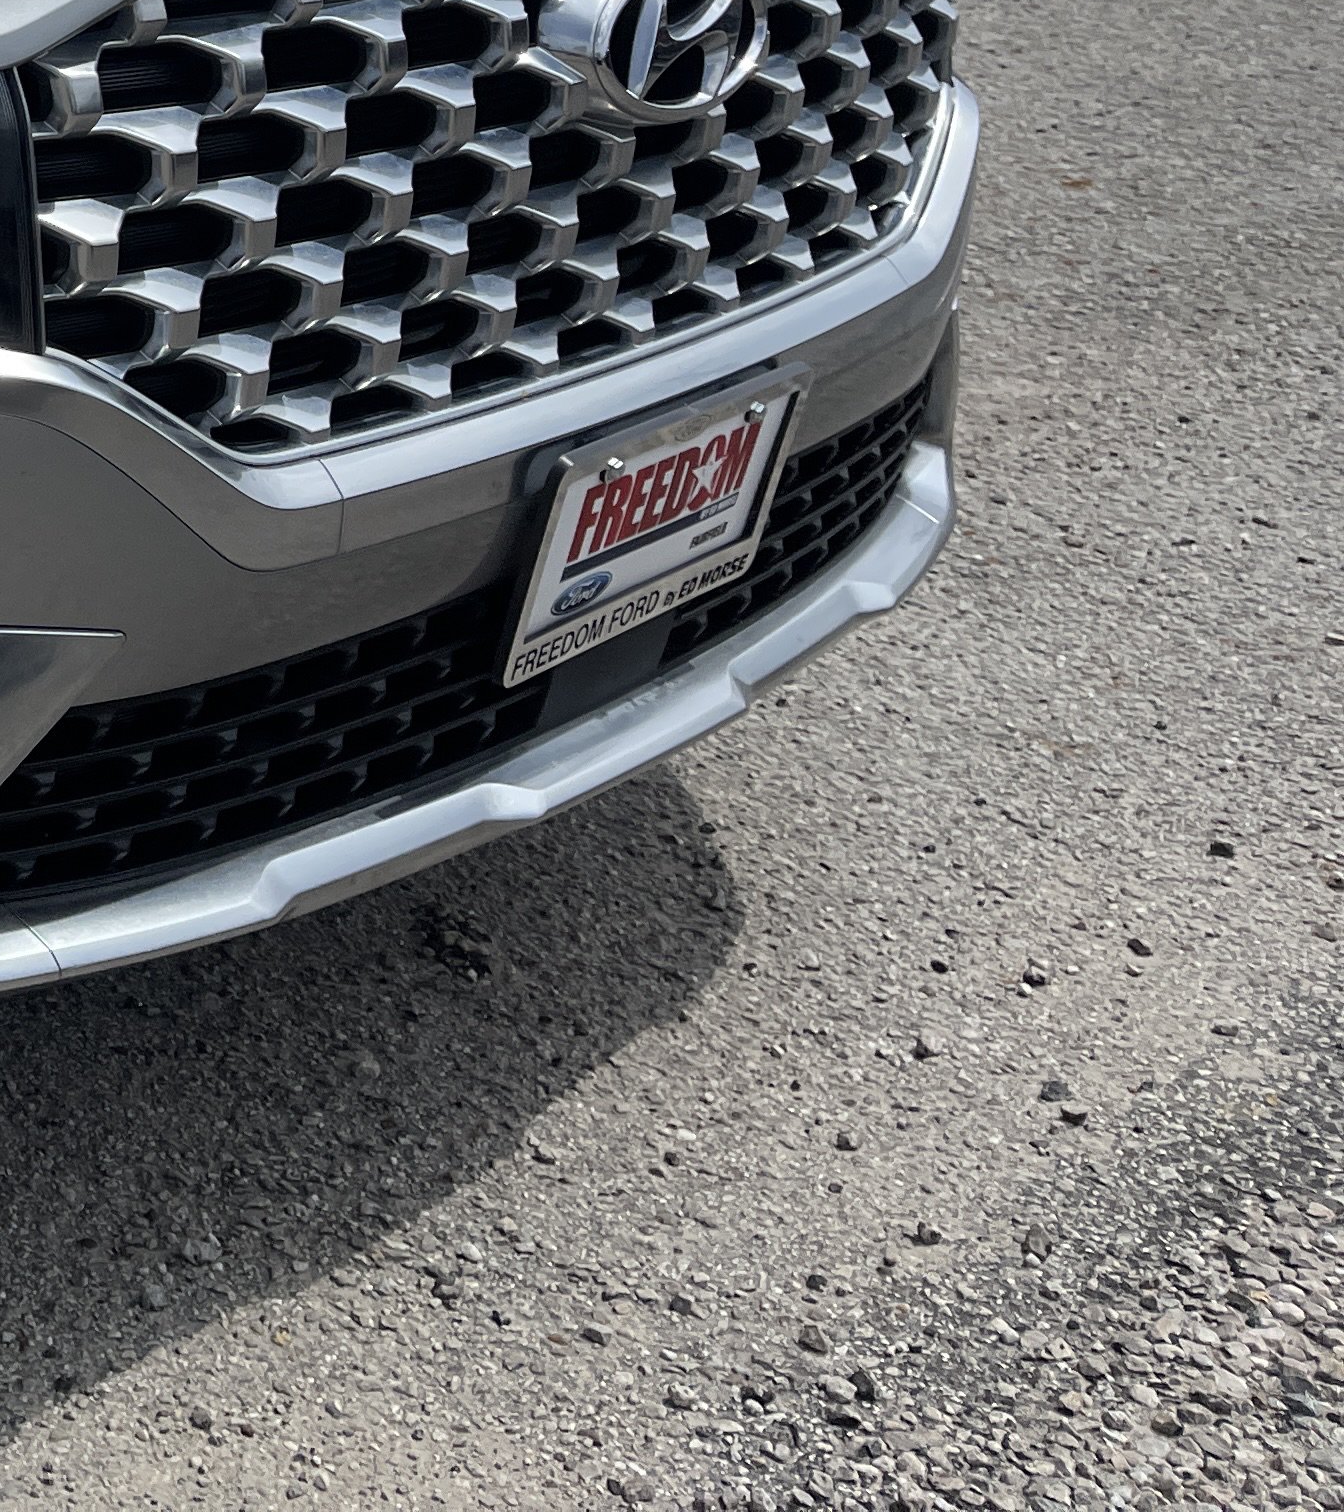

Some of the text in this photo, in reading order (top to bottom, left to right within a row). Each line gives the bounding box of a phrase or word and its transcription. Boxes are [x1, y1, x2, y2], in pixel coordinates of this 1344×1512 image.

[566, 422, 763, 563] FREEDOM
[511, 615, 605, 681] FREEDOM
[608, 590, 660, 634] FORD
[678, 576, 698, 600] ED
[698, 553, 750, 591] MORSE
[561, 578, 602, 610] Ford
